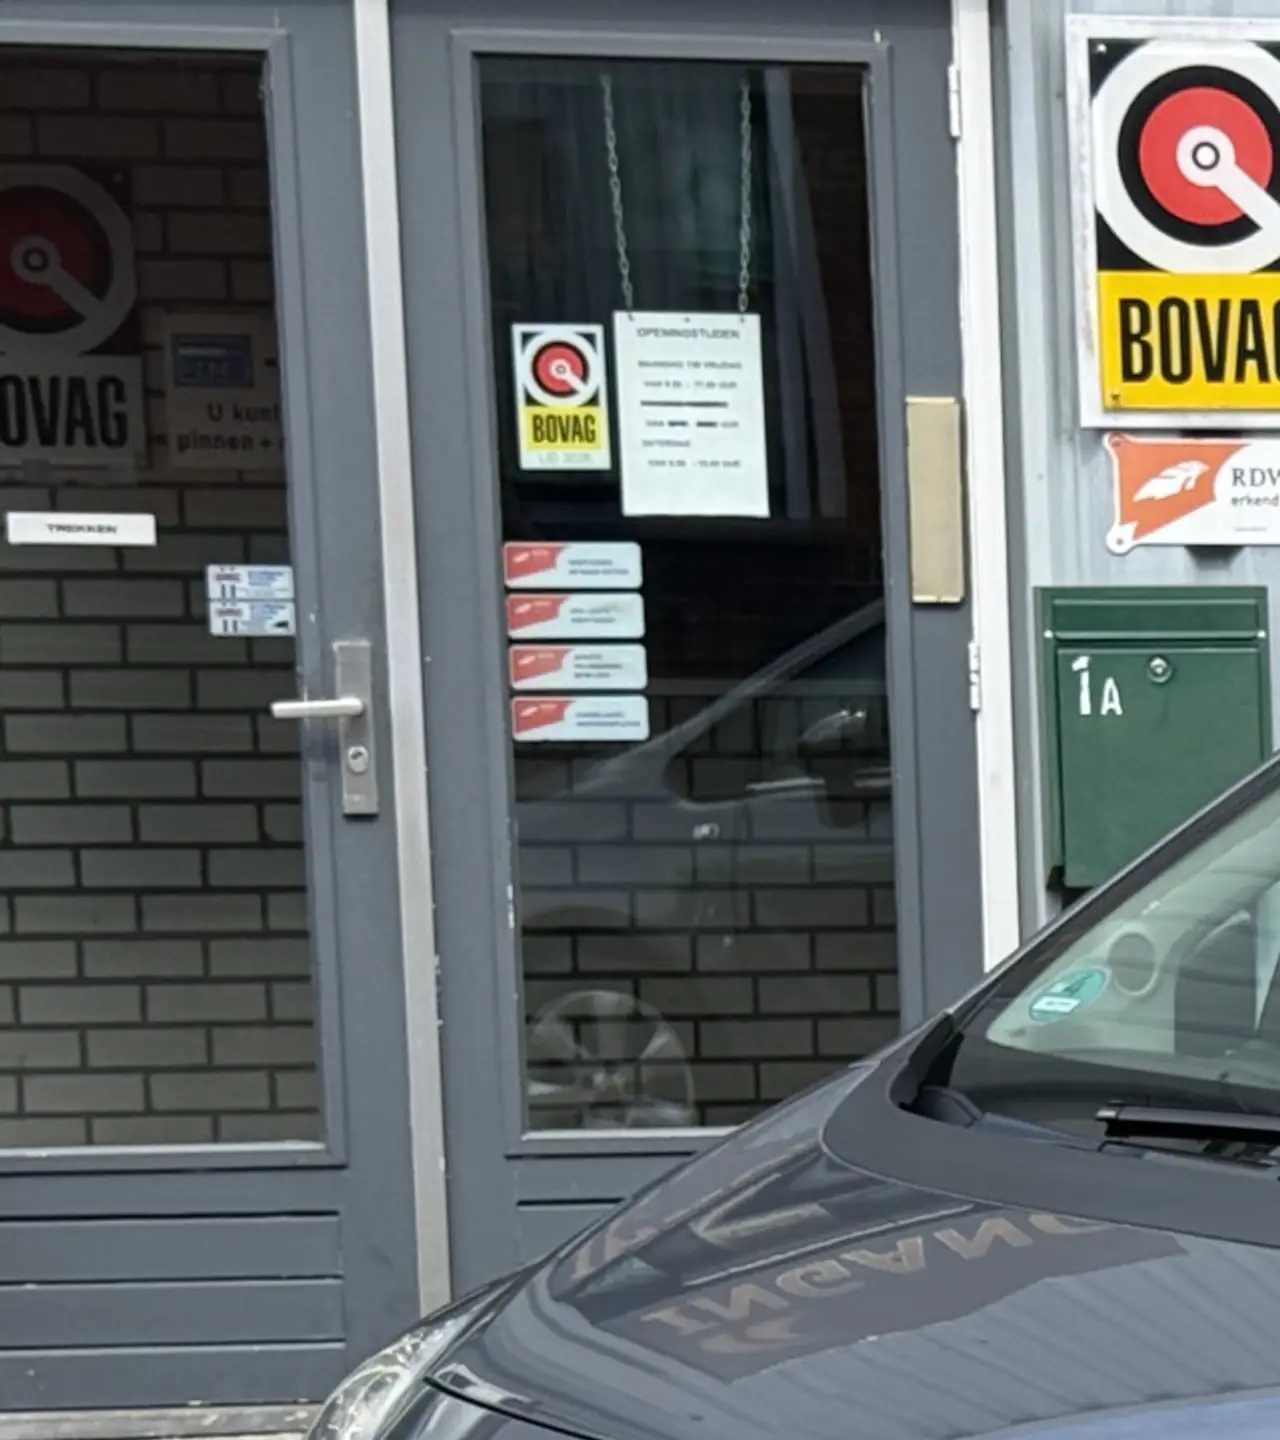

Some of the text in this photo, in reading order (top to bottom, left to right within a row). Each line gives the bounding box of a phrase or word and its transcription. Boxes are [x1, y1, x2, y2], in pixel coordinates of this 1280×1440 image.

[0, 375, 128, 447] OVAG
[532, 414, 596, 443] BOVAG
[1231, 493, 1279, 507] erkend
